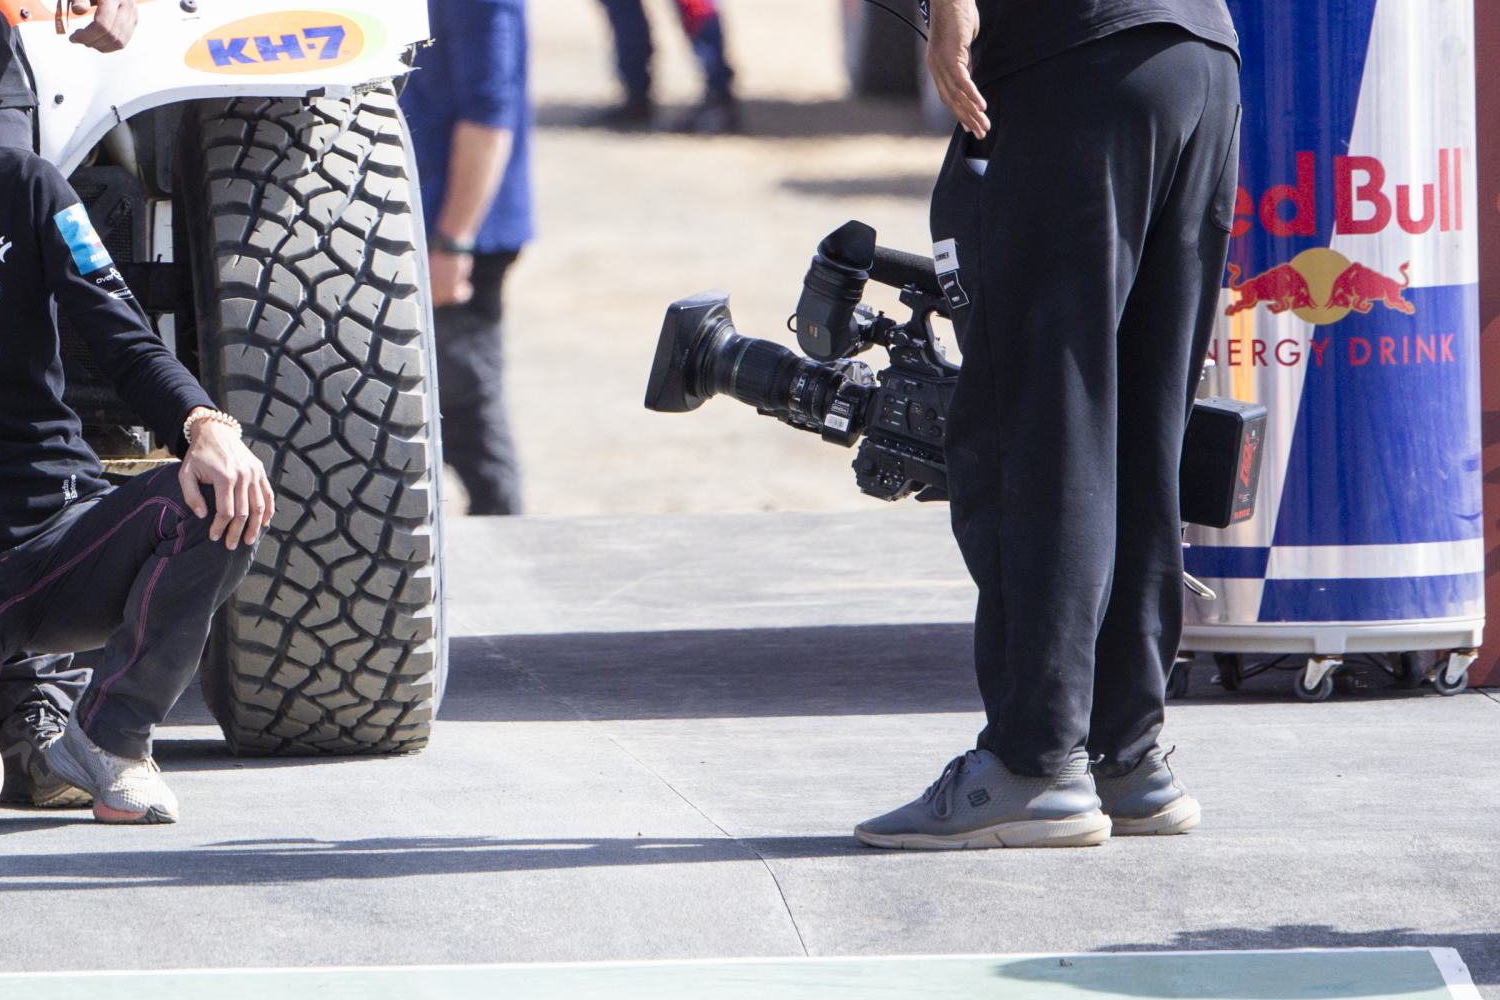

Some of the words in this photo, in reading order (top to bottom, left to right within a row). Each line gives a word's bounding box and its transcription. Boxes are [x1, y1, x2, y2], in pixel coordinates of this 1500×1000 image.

[1334, 148, 1463, 236] Bull
[1206, 338, 1329, 367] NERGY
[1350, 334, 1455, 366] DRINK
